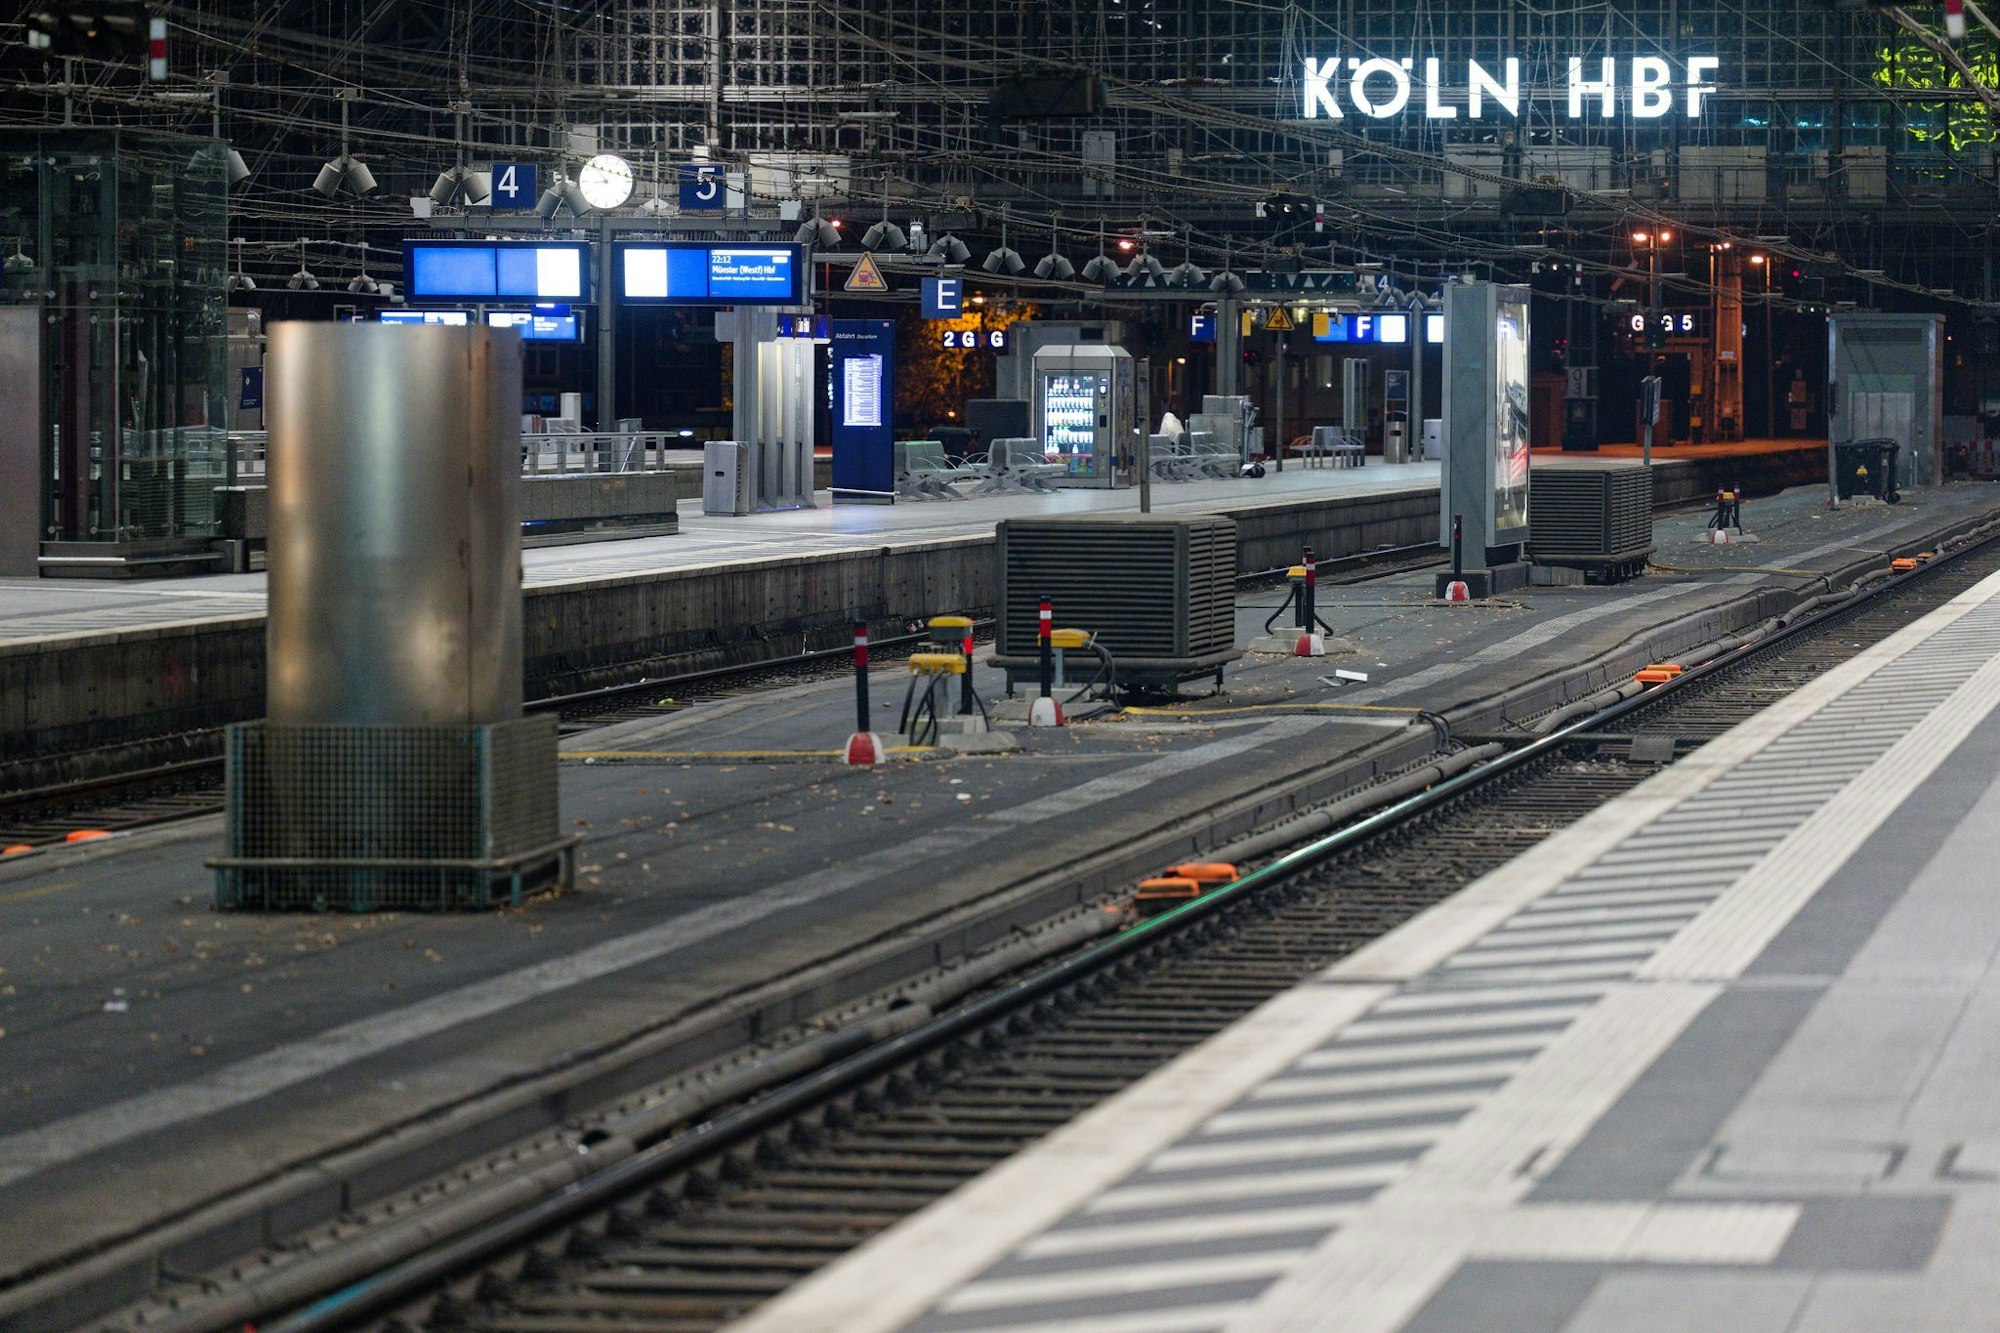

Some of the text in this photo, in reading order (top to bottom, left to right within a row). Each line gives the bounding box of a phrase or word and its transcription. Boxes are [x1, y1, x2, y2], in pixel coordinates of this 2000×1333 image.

[1303, 56, 1720, 118] KÖLN HBF
[498, 165, 519, 198] 4
[695, 167, 717, 200] 5
[712, 255, 732, 263] 22:12
[712, 265, 738, 274] Münster
[740, 265, 763, 275] (Westf)
[1378, 275, 1390, 290] 4
[937, 280, 956, 309] E
[1191, 315, 1205, 336] F
[1357, 316, 1372, 338] F
[1631, 315, 1645, 331] G
[1682, 315, 1693, 331] 5
[943, 331, 1004, 347] 2 G G
